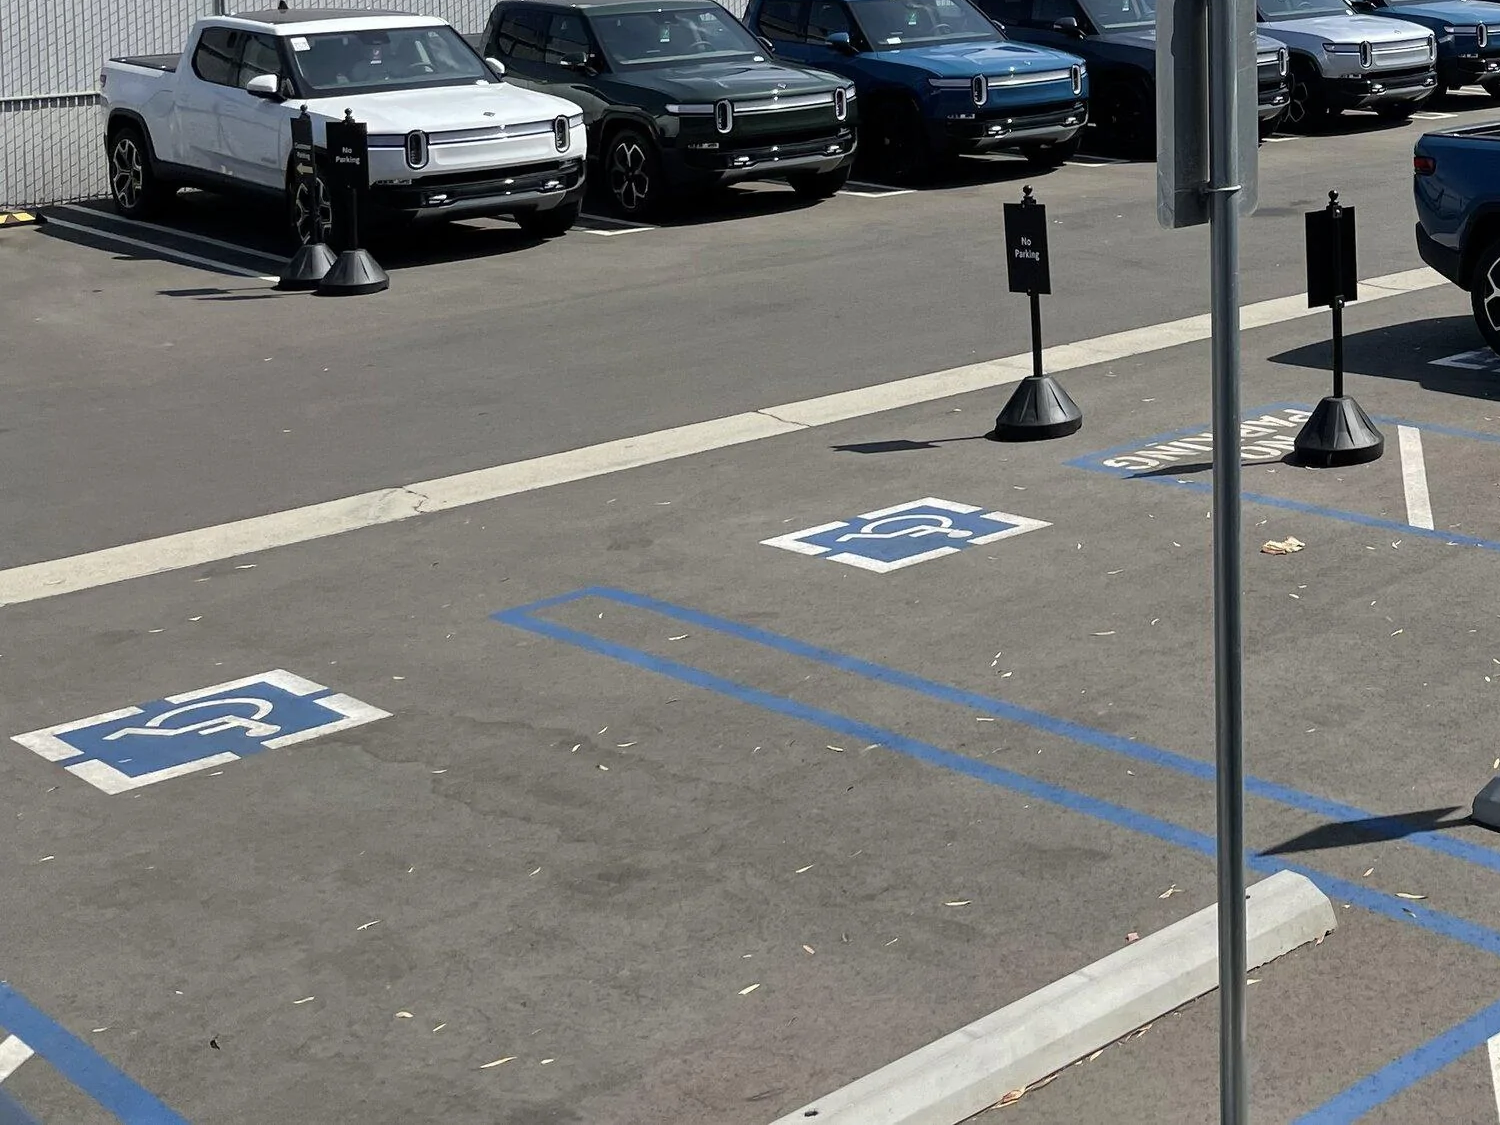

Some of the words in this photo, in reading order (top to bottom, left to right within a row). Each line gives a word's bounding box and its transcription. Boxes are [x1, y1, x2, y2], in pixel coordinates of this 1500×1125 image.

[342, 146, 353, 154] No
[335, 156, 361, 165] Parking
[1020, 236, 1032, 246] No
[1014, 248, 1040, 262] Parking
